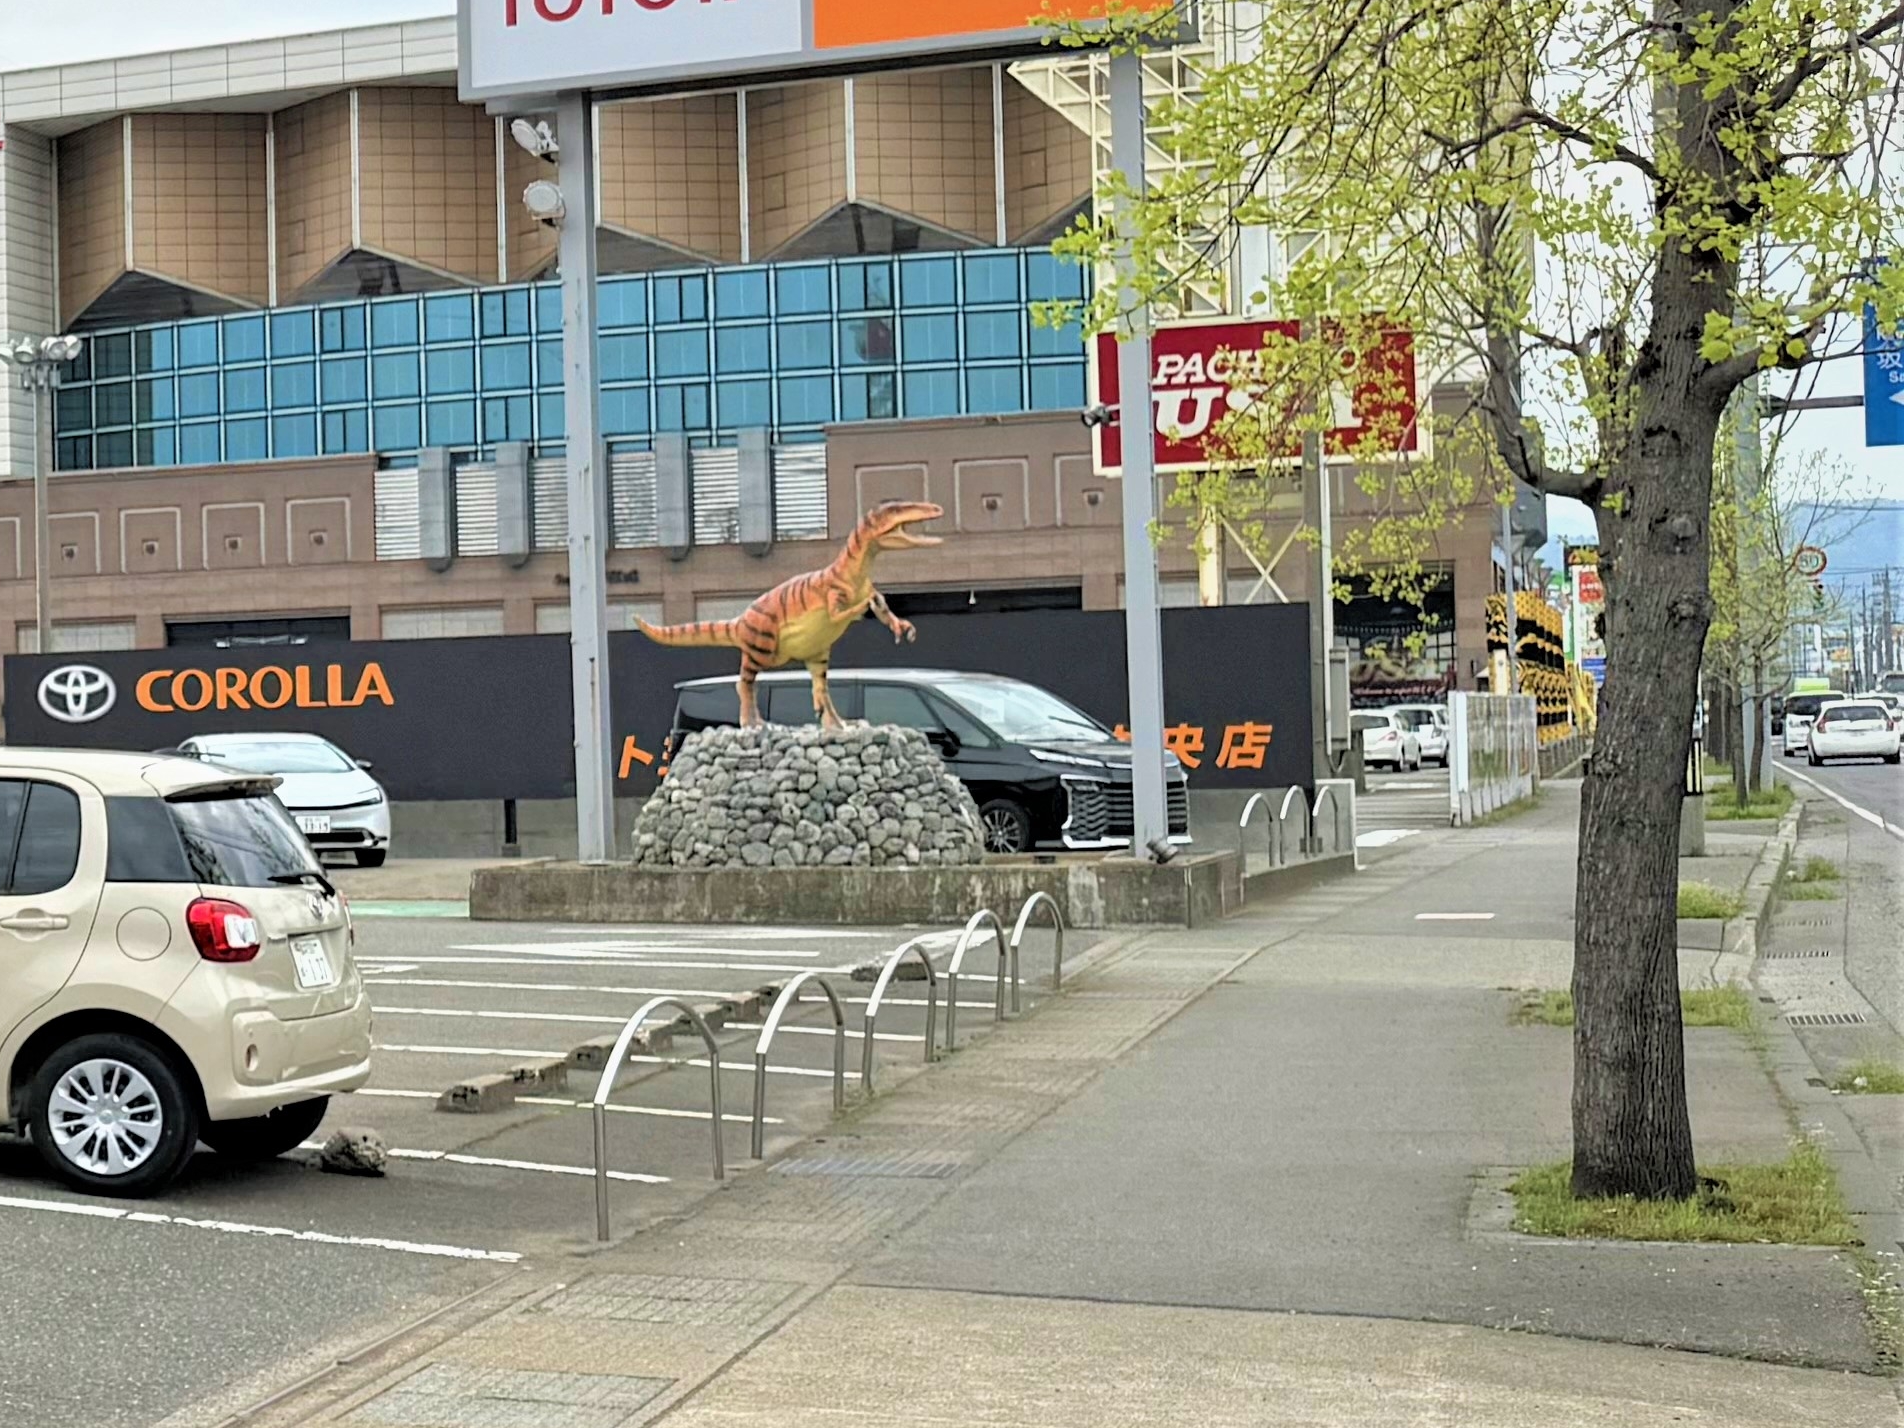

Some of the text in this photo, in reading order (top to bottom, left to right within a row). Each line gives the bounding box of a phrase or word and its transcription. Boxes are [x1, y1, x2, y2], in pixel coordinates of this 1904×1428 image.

[1152, 346, 1360, 385] PACHO
[135, 662, 394, 713] COROLLA
[1113, 721, 1273, 769] 央店
